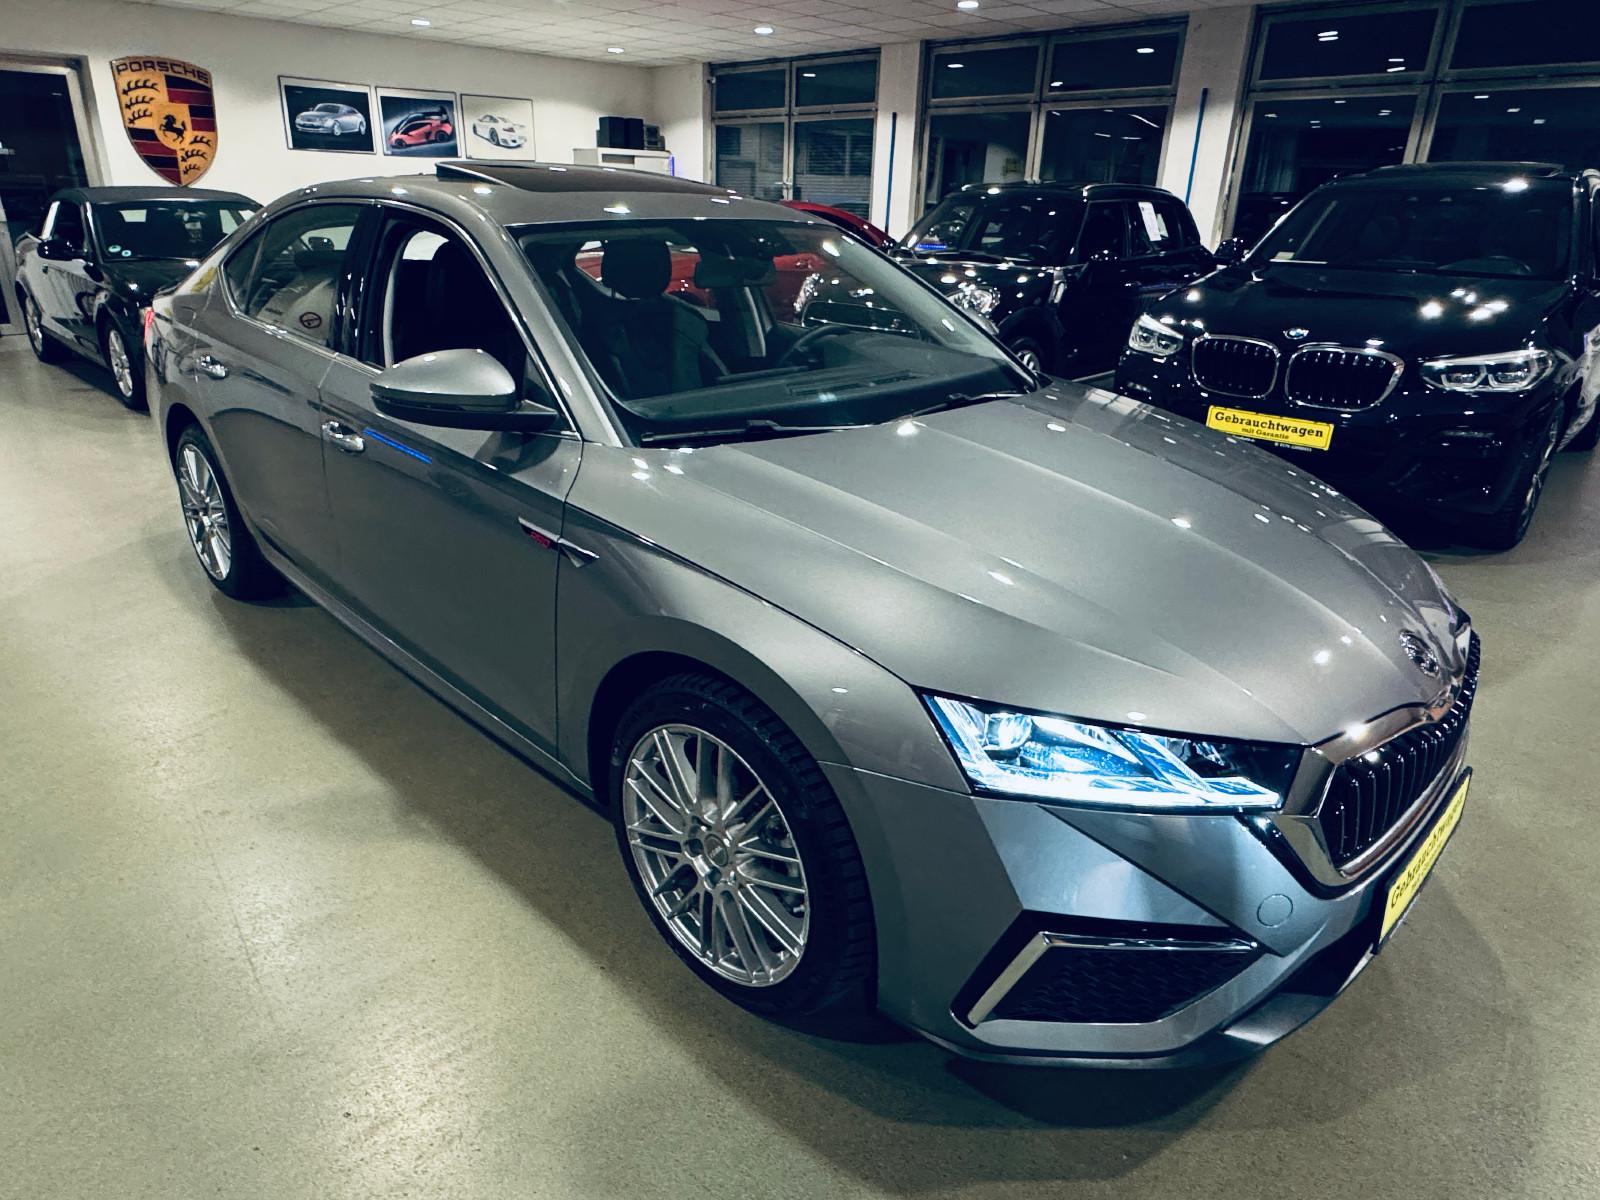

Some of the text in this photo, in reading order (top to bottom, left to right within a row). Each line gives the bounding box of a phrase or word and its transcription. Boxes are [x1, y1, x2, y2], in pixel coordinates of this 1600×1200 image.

[116, 60, 209, 85] PORSCHE
[1215, 411, 1323, 438] Gebrauchtwagen
[1242, 427, 1254, 436] mit
[1256, 429, 1289, 440] Garantie
